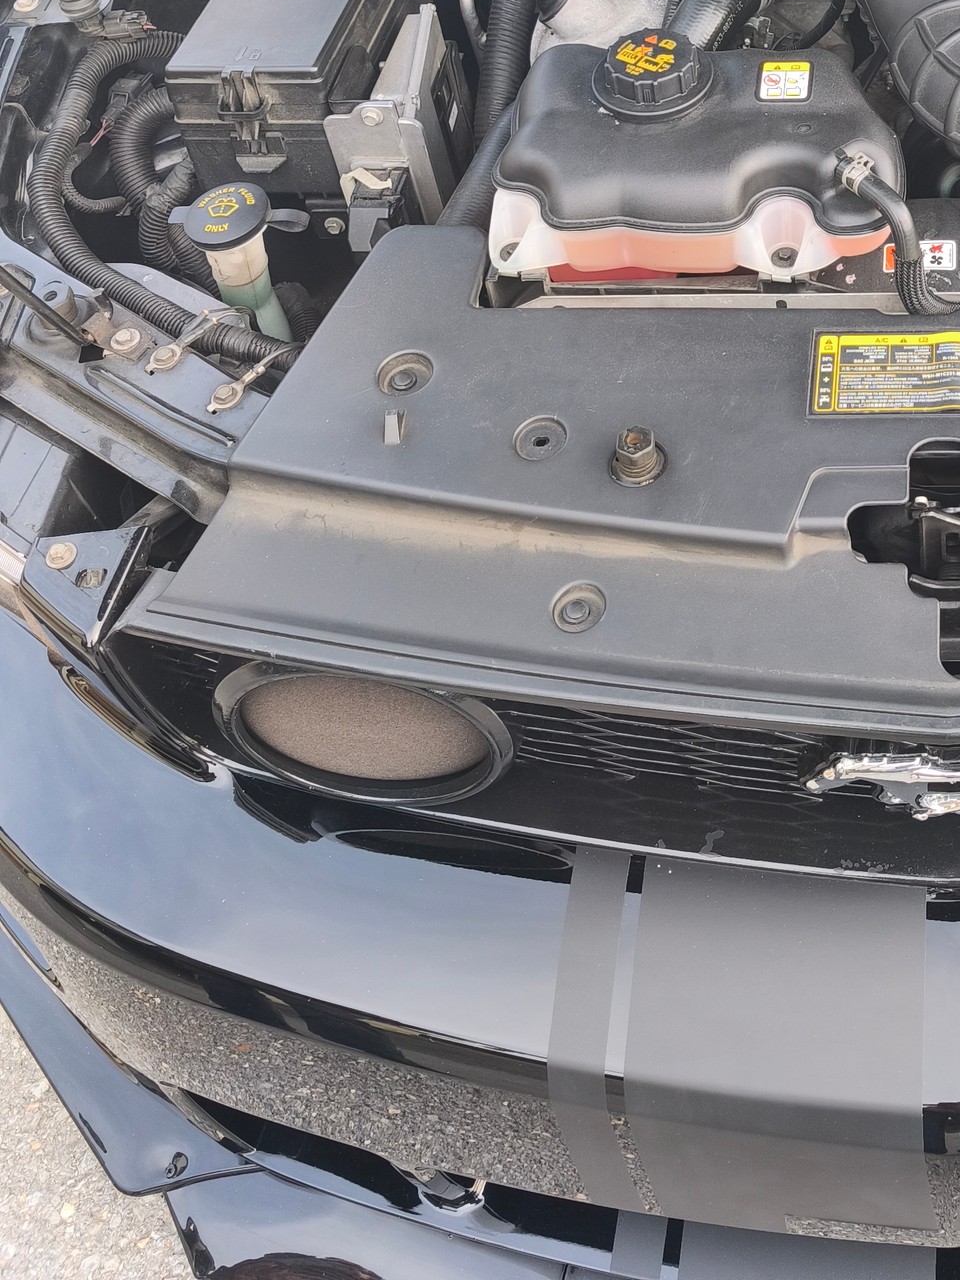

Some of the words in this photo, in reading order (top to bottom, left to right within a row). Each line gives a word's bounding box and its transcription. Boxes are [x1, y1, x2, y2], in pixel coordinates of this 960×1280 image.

[197, 187, 236, 208] WASHER
[237, 187, 255, 205] FLUID
[204, 223, 229, 232] ONLY
